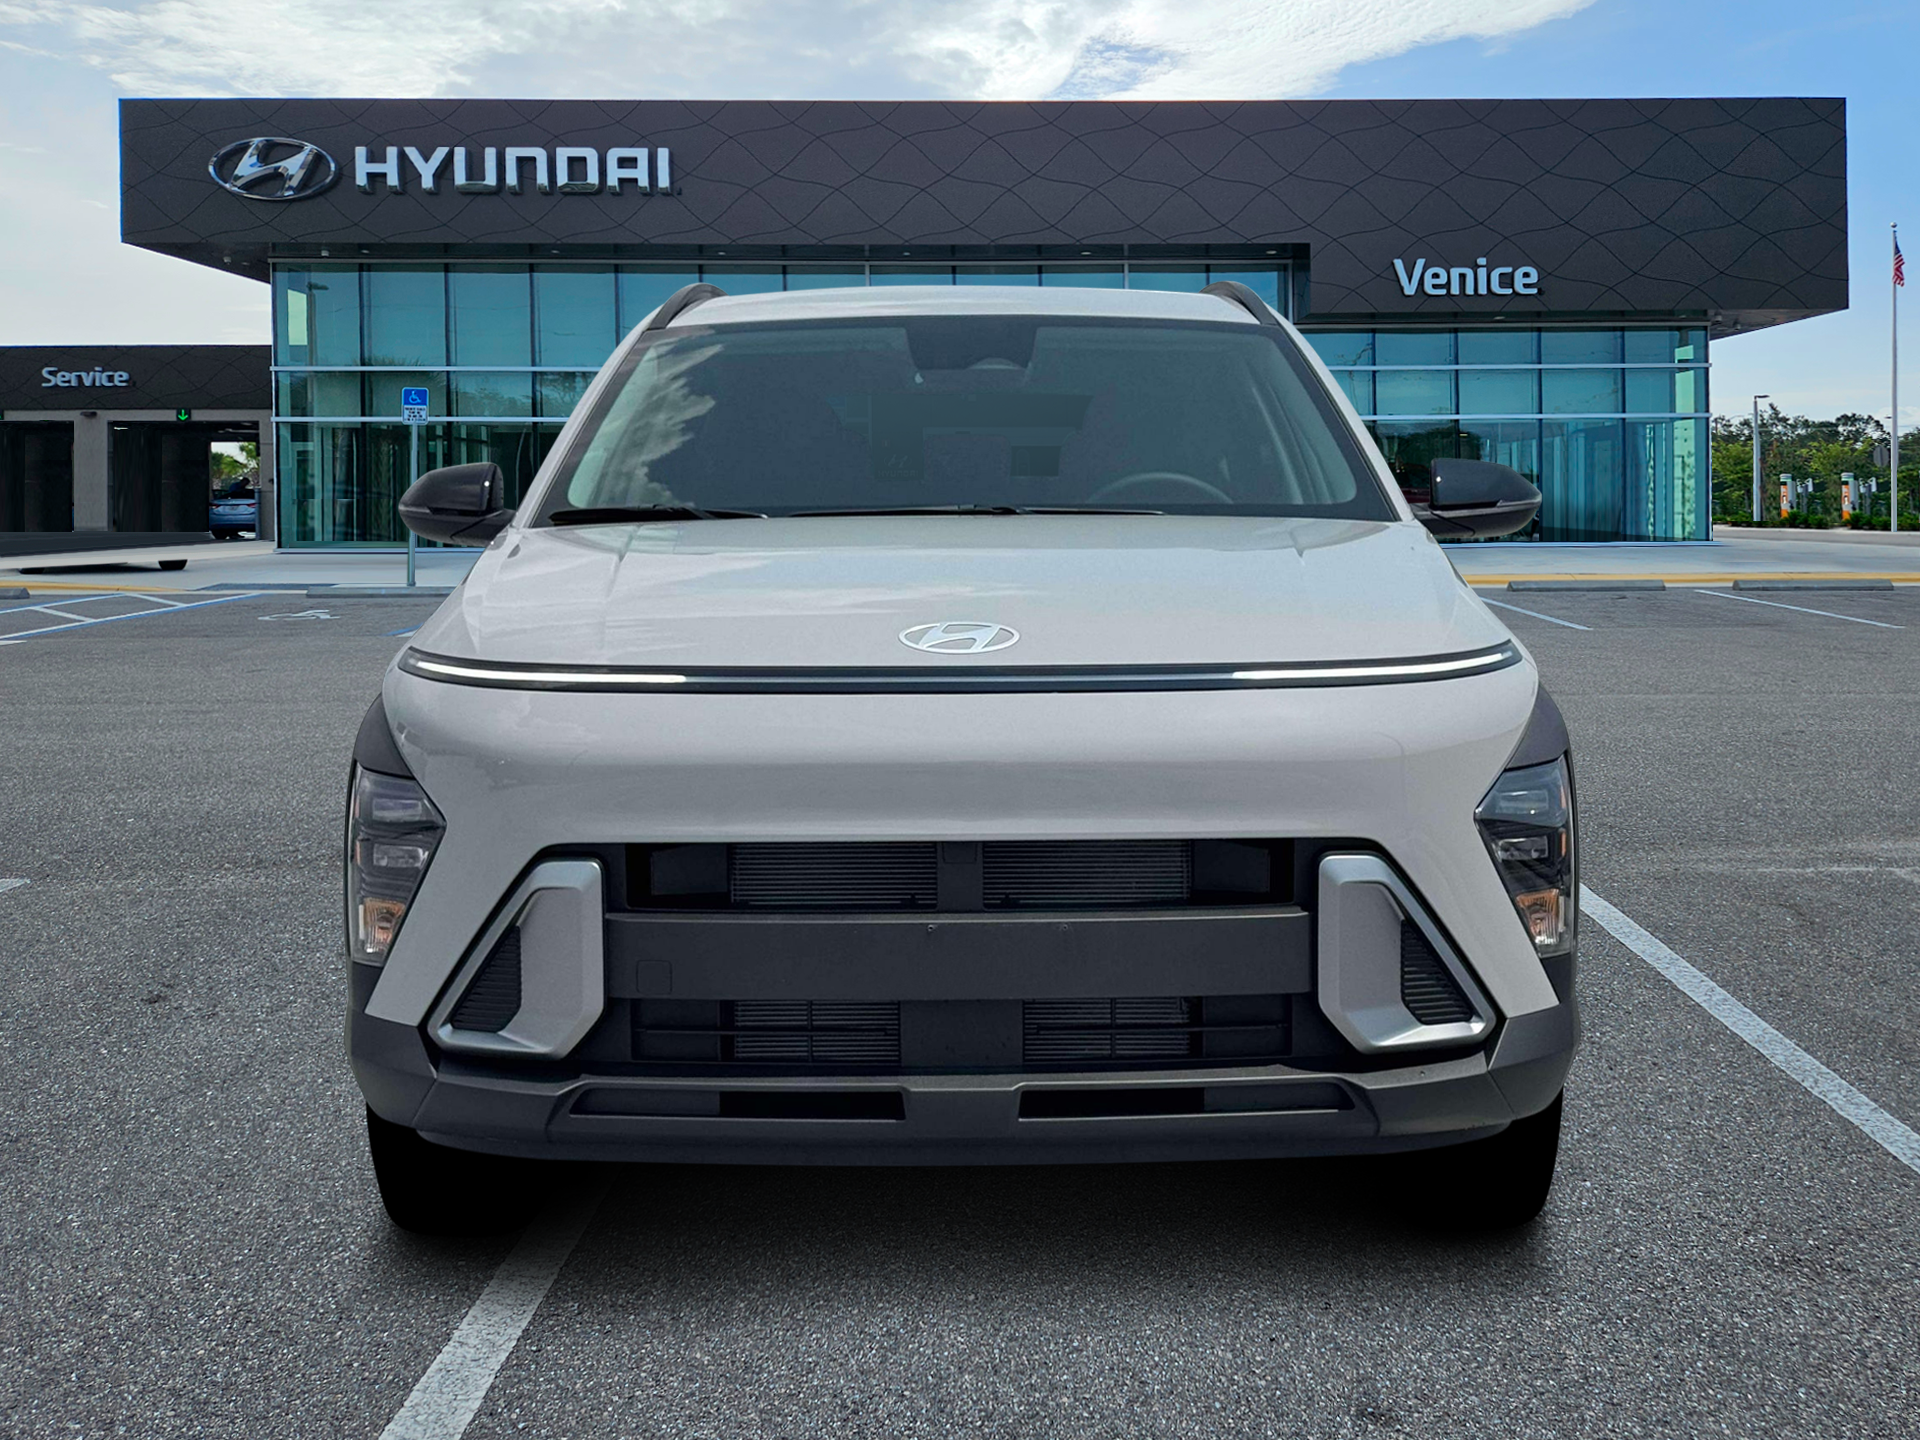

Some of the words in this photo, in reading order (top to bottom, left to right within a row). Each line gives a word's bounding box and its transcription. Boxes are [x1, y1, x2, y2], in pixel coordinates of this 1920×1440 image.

[354, 146, 672, 195] HYUNDAI
[1393, 257, 1540, 296] Venice
[41, 366, 131, 387] Service
